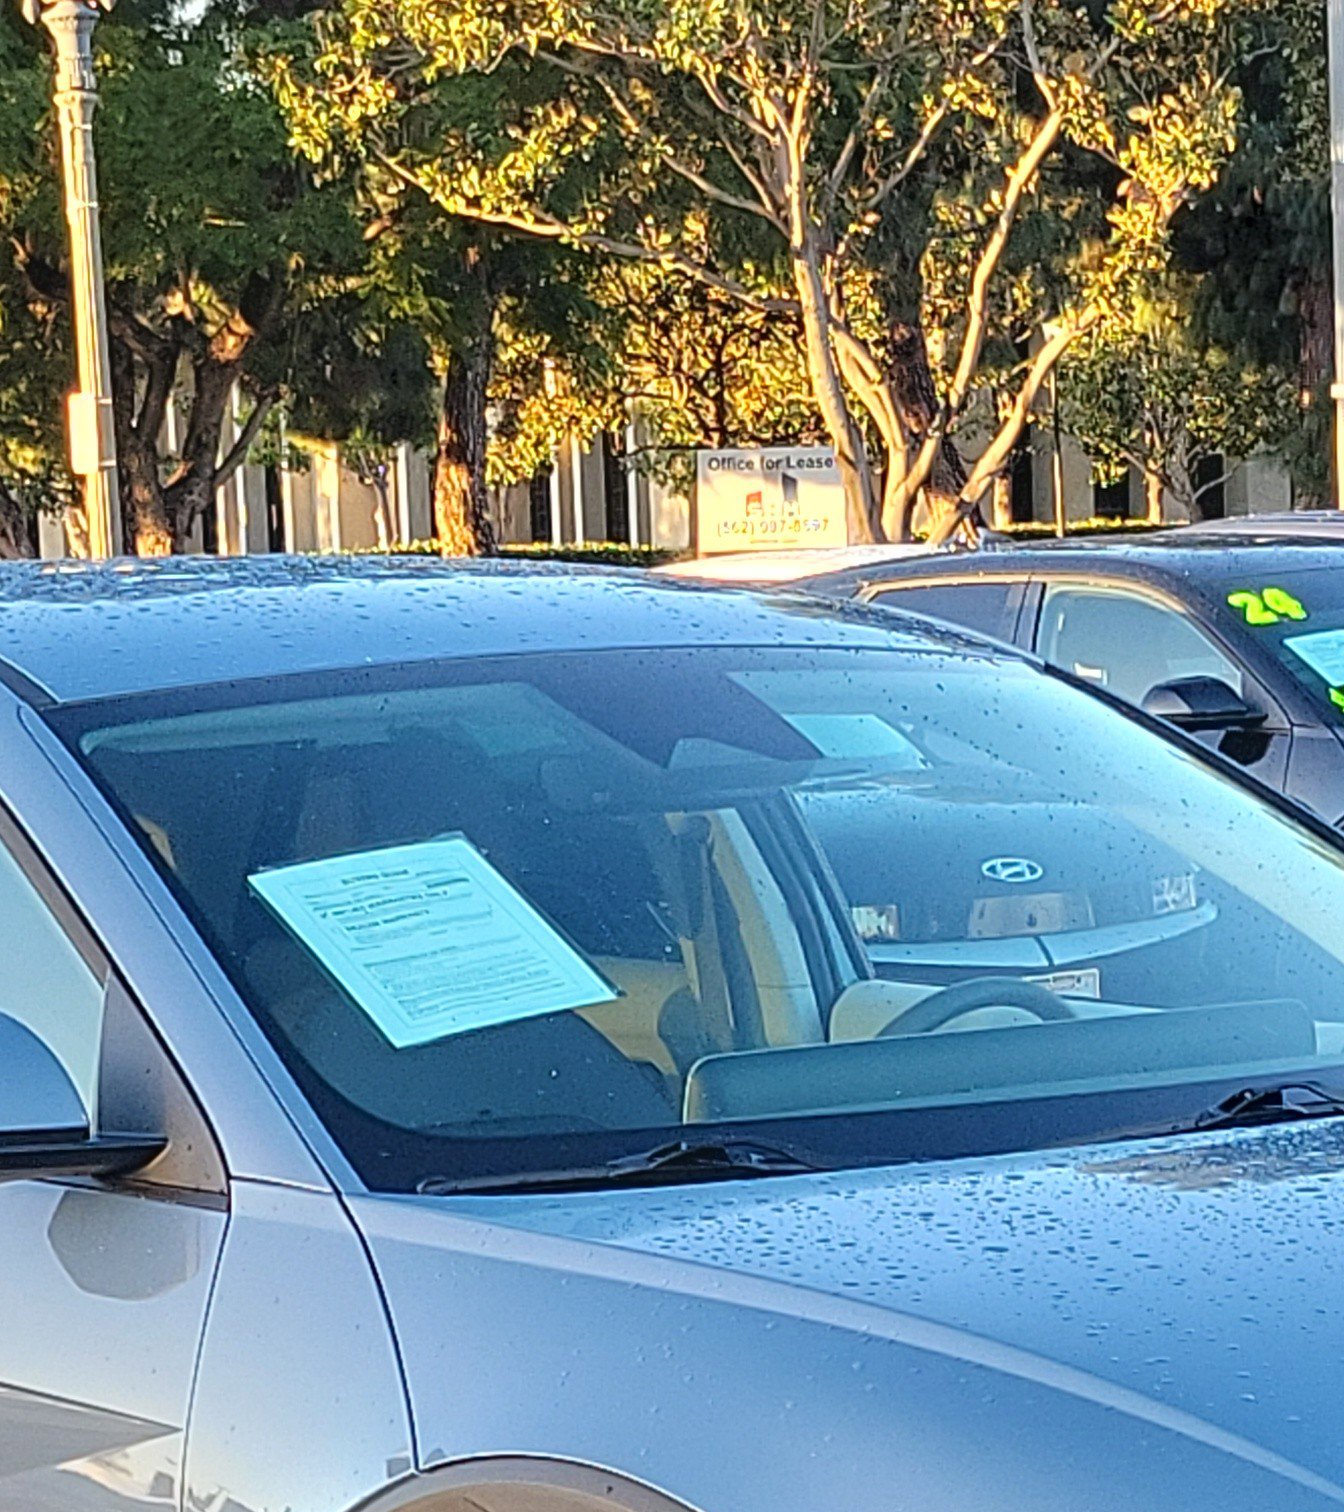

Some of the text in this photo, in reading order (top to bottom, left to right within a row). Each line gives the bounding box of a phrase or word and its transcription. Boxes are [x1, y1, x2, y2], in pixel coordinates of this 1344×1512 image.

[708, 457, 754, 471] Office
[786, 455, 833, 469] Lease
[1227, 587, 1307, 626] 24
